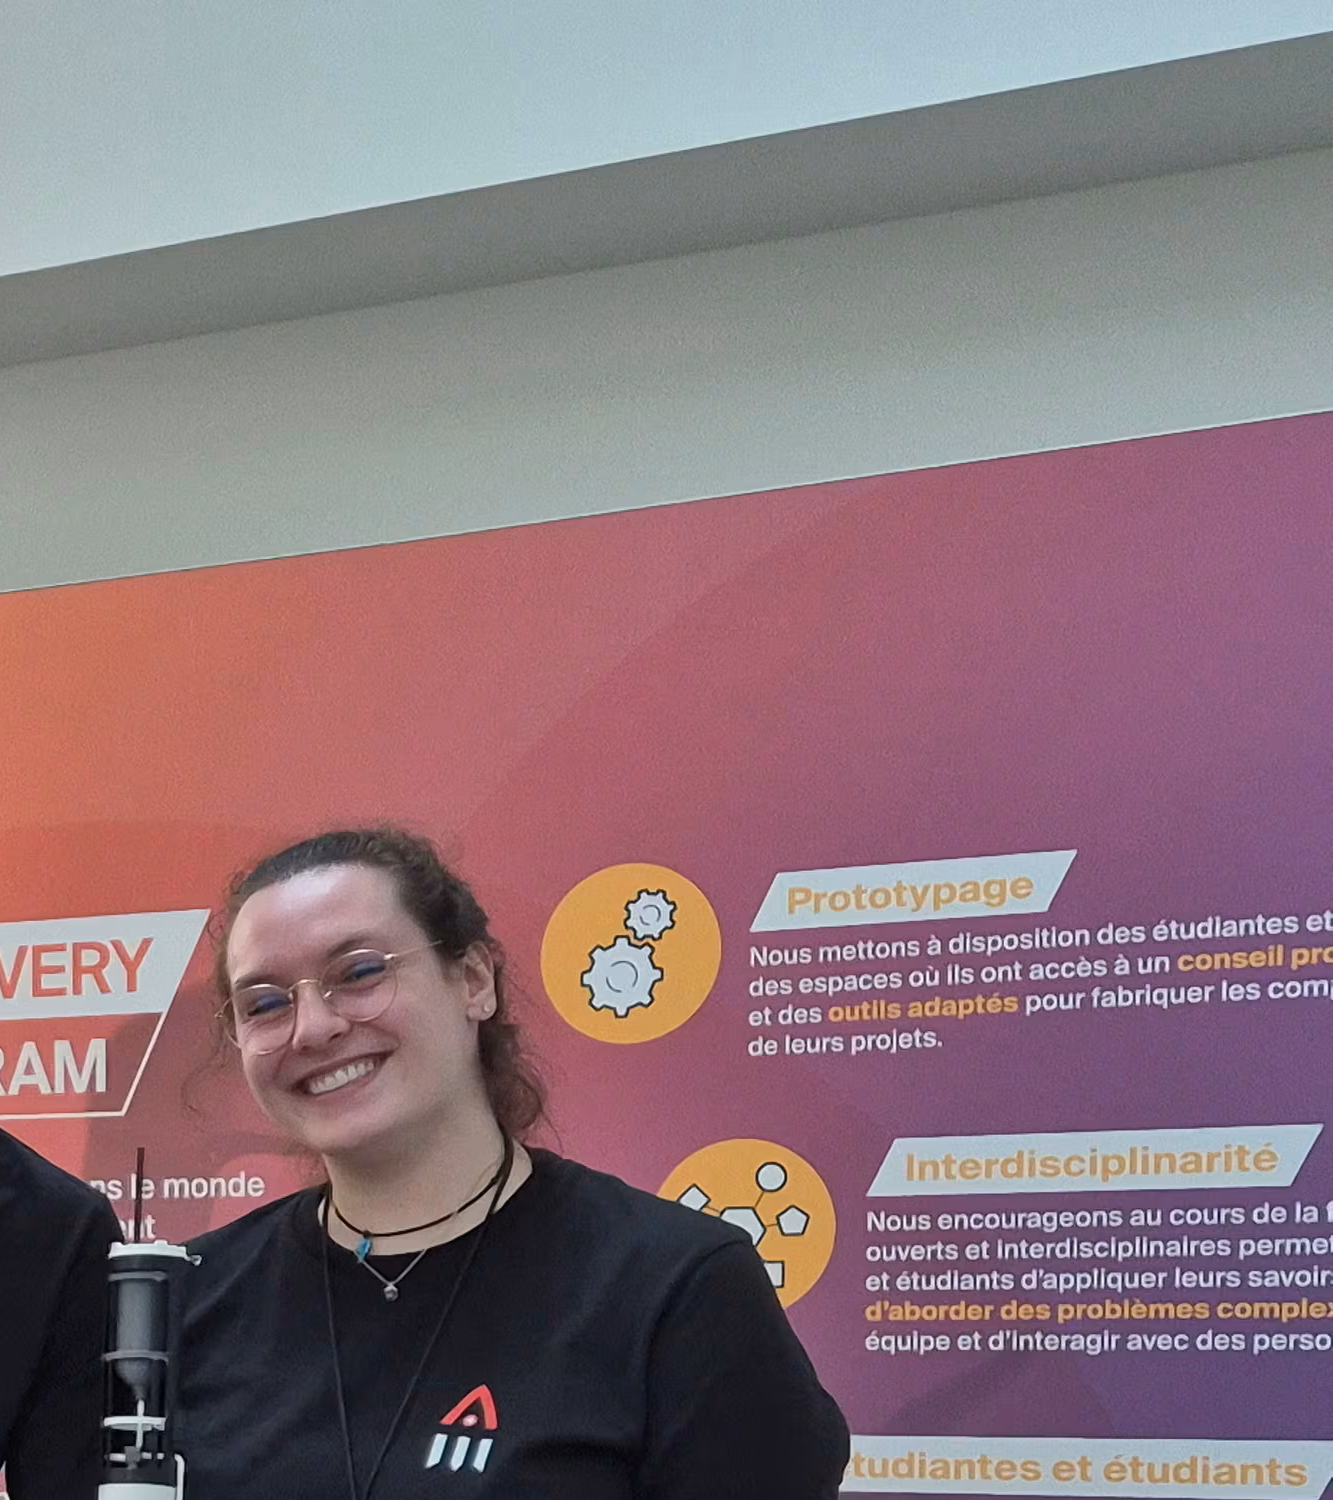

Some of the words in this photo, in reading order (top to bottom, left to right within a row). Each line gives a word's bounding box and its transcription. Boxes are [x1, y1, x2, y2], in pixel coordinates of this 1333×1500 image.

[787, 876, 1035, 914] Prototypage
[749, 945, 813, 969] Nous
[818, 939, 920, 964] mettons
[926, 934, 942, 956] à
[948, 925, 1091, 957] disposition
[1096, 922, 1147, 945] des
[1152, 913, 1300, 942] étudiantes
[1305, 909, 1333, 933] et
[748, 975, 794, 998] des
[798, 972, 903, 997] espaces
[908, 965, 940, 988] où
[947, 963, 975, 986] ils
[980, 960, 1023, 984] ont
[1028, 955, 1108, 981] accès
[1113, 953, 1131, 976] à
[1137, 956, 1170, 975] un
[1177, 944, 1284, 972] conseil
[747, 1006, 773, 1027] et
[777, 1003, 823, 1026] des
[828, 999, 902, 1022] outils
[907, 992, 1019, 1020] adaptés
[1025, 992, 1086, 1017] pour
[1090, 983, 1216, 1010] fabriquer
[1221, 979, 1262, 1002] les
[1267, 979, 1333, 999] com
[747, 1035, 779, 1057] de
[784, 1033, 845, 1055] leurs
[850, 1027, 943, 1056] projets.
[906, 1142, 1278, 1182] Interdisciplinarité
[163, 1171, 265, 1198] monde
[866, 1210, 932, 1233] Nous
[937, 1210, 1124, 1233] encourageons
[1129, 1208, 1162, 1227] au
[1169, 1207, 1246, 1226] cours
[1251, 1201, 1287, 1225] de
[1294, 1201, 1319, 1224] la
[865, 1240, 959, 1262] ouverts
[964, 1240, 990, 1261] et
[996, 1235, 1232, 1263] interdisciplinaires
[1238, 1234, 1333, 1261] perme
[865, 1271, 891, 1292] et
[895, 1269, 1015, 1292] étudiants
[1020, 1267, 1168, 1295] d'appliquer
[1174, 1266, 1242, 1289] leurs
[1247, 1264, 1333, 1288] savoir
[864, 1300, 995, 1322] d'aborder
[1000, 1299, 1051, 1321] des
[1057, 1298, 1210, 1324] problèmes
[864, 1329, 951, 1356] équipe
[956, 1330, 983, 1351] et
[987, 1329, 1122, 1356] d'interagir
[1126, 1333, 1190, 1351] avec
[1195, 1328, 1246, 1351] des
[847, 1451, 1042, 1482] tudiantes
[1052, 1455, 1093, 1483] et
[1103, 1454, 1308, 1487] étudiants
